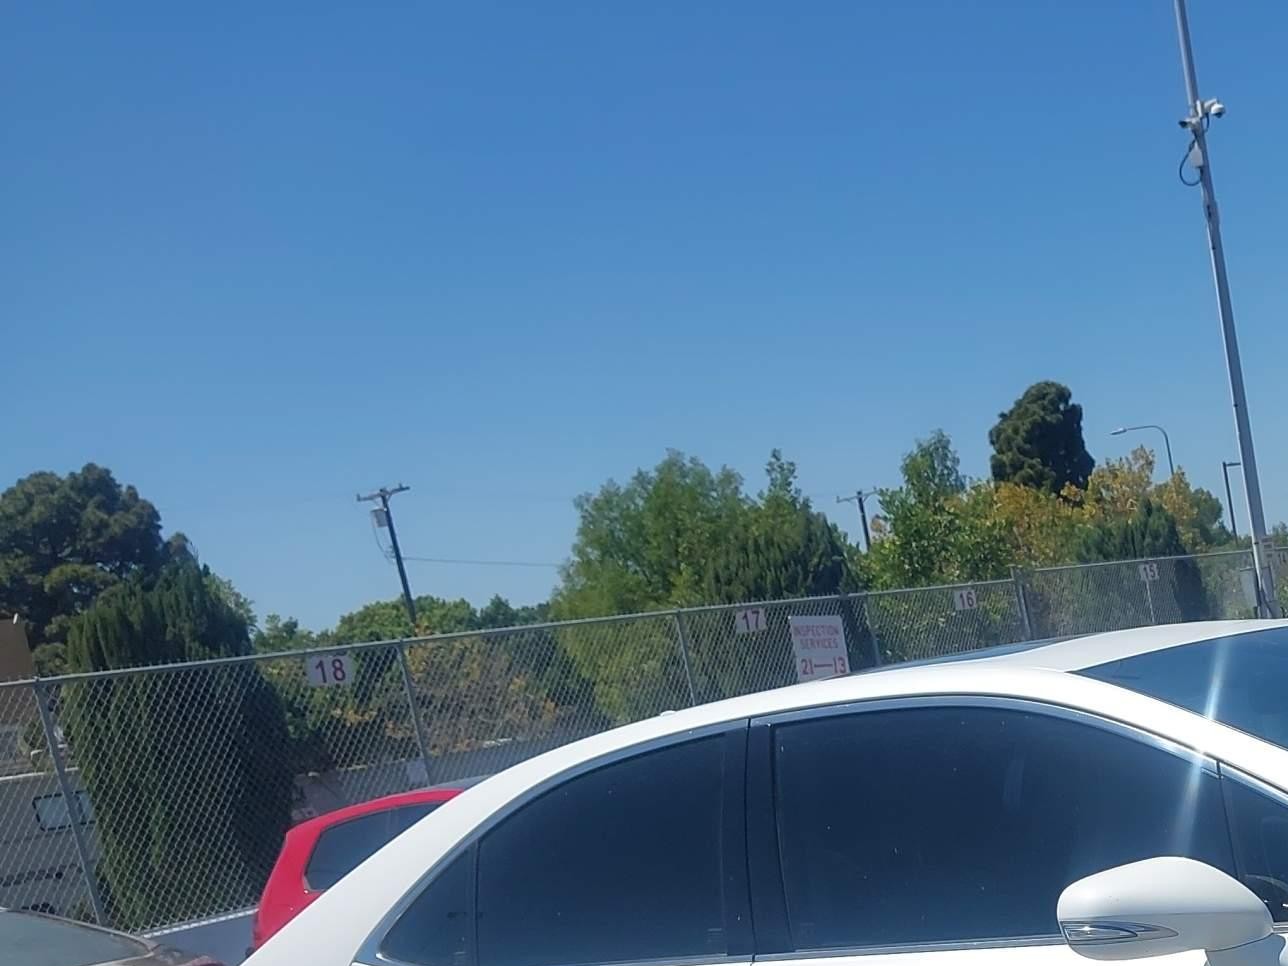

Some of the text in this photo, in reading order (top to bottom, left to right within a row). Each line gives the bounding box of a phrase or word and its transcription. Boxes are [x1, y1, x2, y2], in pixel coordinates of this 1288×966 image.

[1143, 563, 1156, 579] 15
[960, 591, 975, 608] 16
[742, 610, 760, 630] 17
[315, 658, 346, 683] 18
